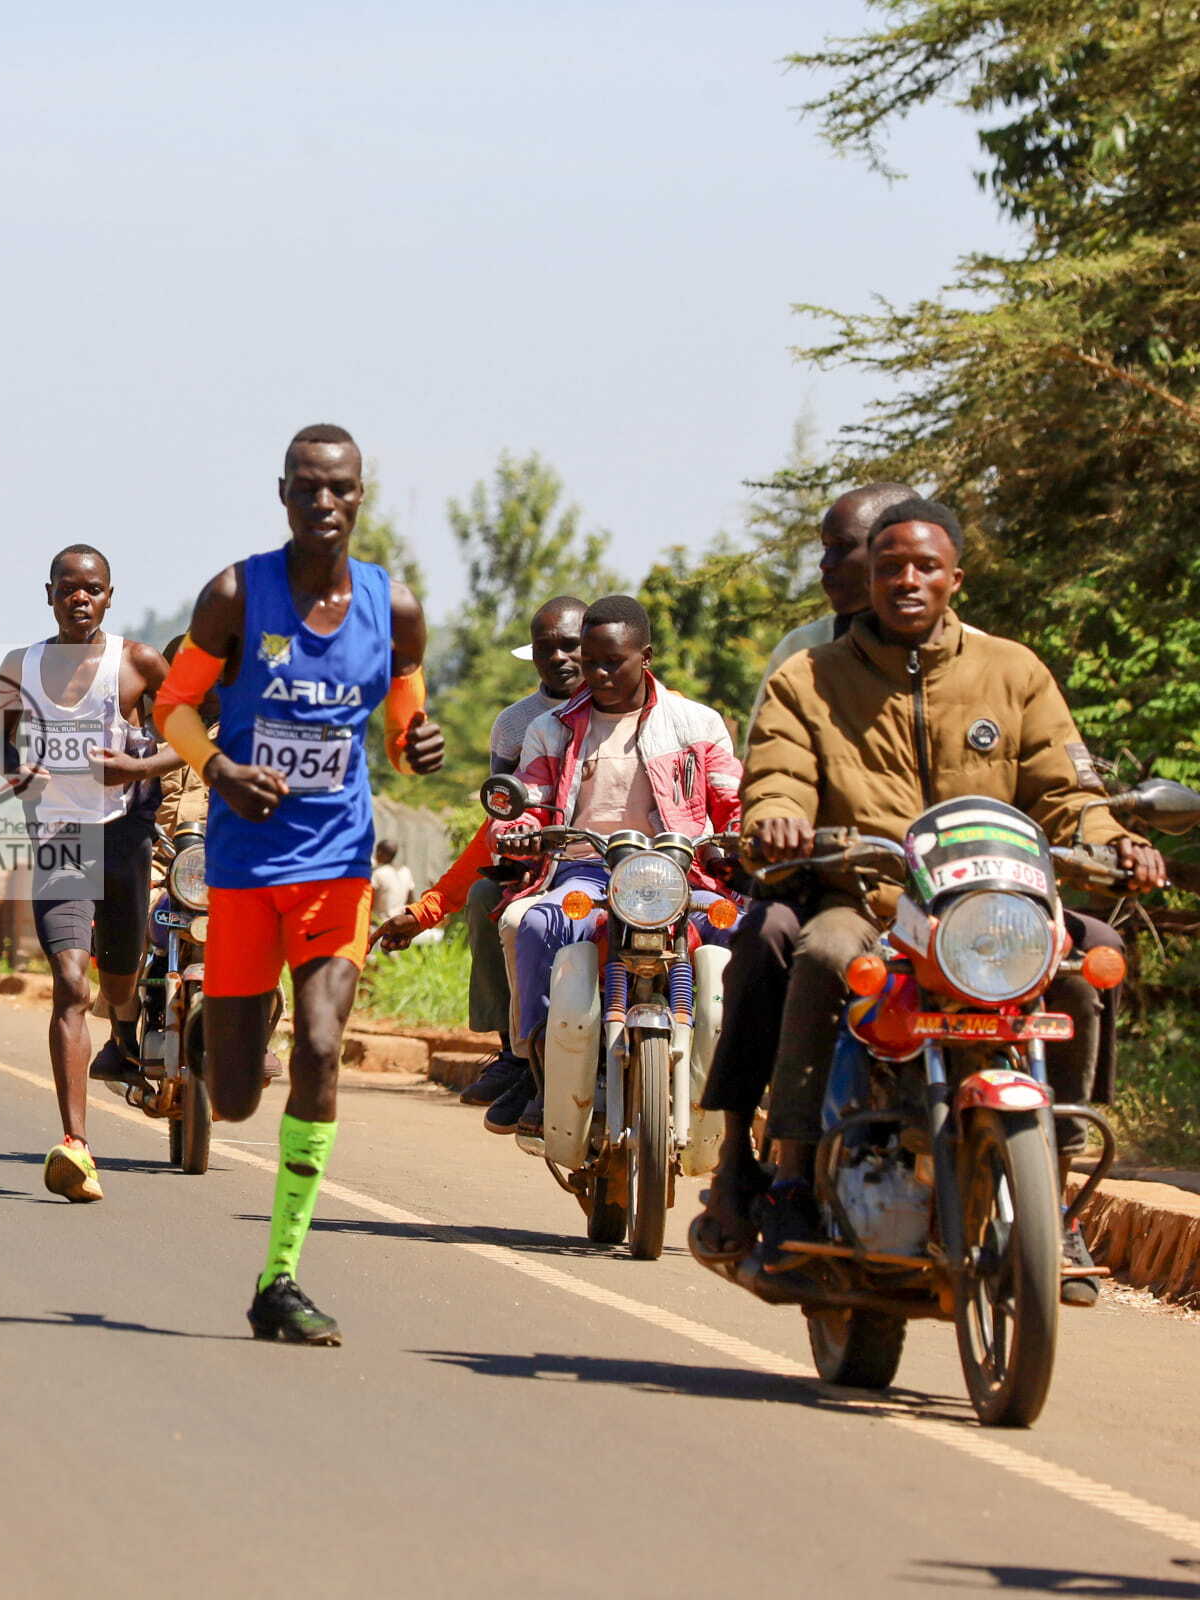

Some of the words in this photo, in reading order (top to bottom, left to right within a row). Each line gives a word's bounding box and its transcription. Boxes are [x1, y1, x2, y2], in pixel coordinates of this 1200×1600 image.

[261, 677, 362, 707] ARUA
[256, 743, 342, 778] 0954
[937, 871, 945, 887] I
[972, 860, 1004, 877] MY
[1012, 863, 1045, 889] JOB
